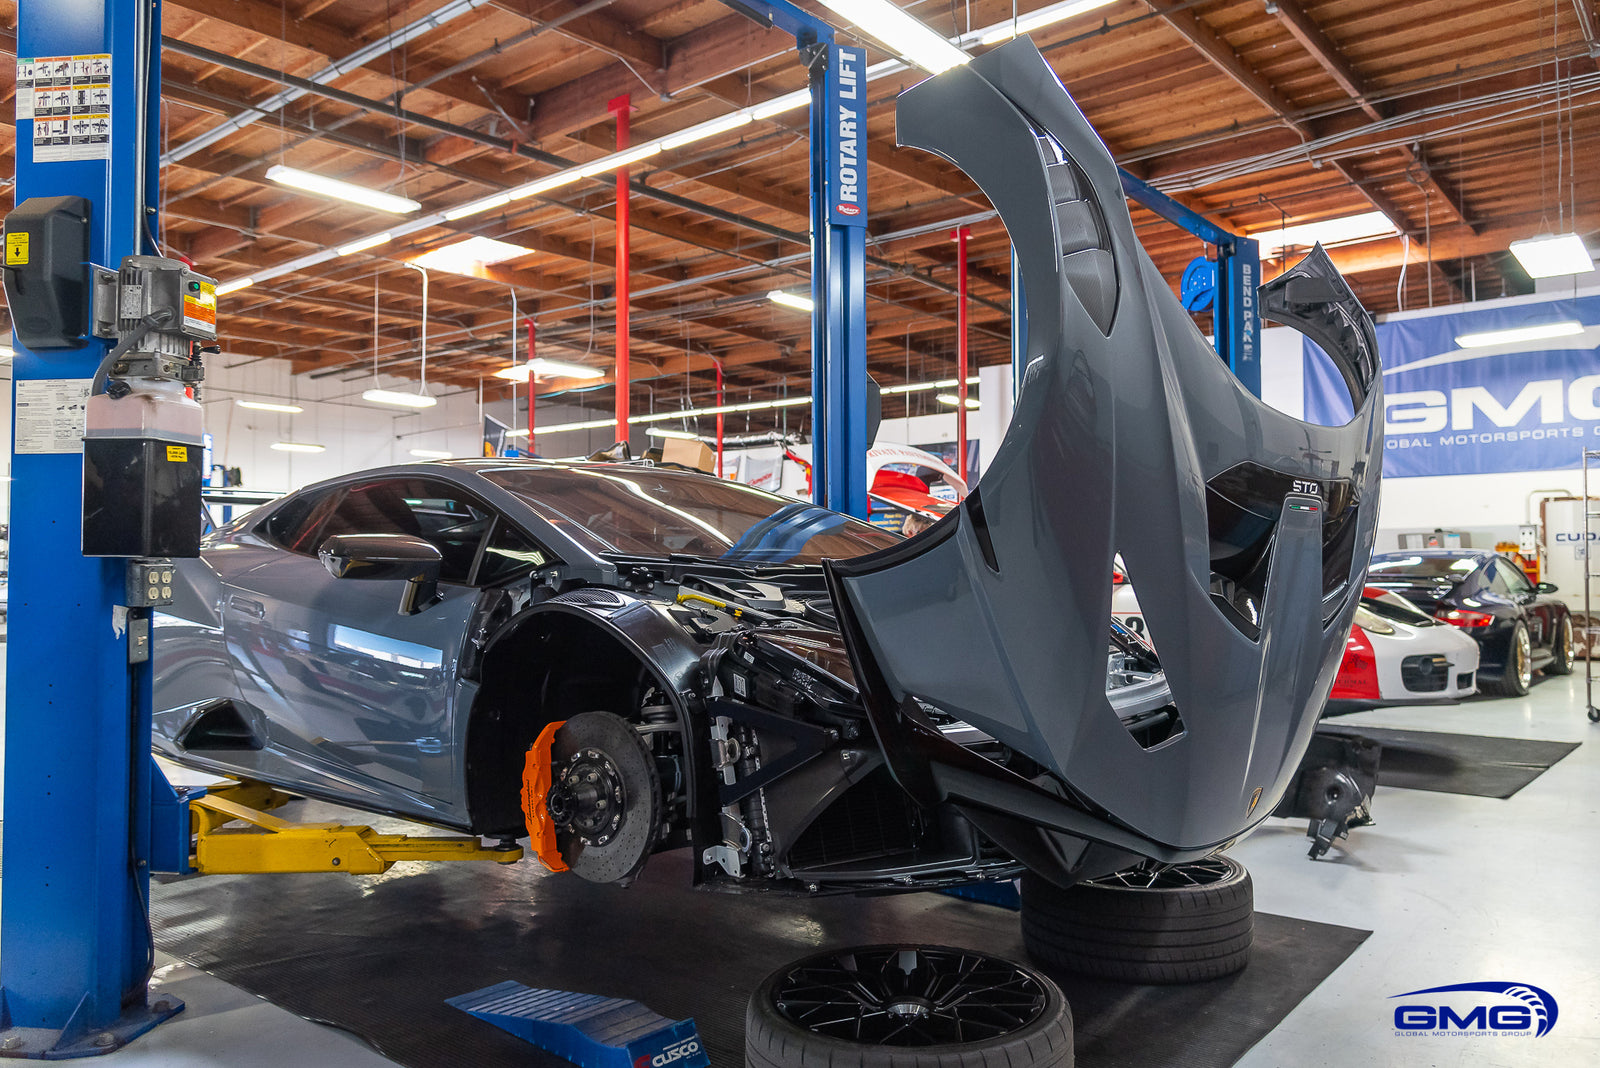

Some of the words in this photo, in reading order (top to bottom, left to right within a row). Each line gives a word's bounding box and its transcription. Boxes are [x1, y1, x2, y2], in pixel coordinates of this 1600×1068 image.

[838, 48, 857, 100] LIFT
[839, 104, 858, 203] ROTARY
[1242, 263, 1252, 307] BEND
[1384, 374, 1600, 436] GM
[1384, 438, 1432, 450] OBAL
[1439, 426, 1585, 446] MOTORSPORTS
[1292, 479, 1319, 495] STO
[1556, 532, 1600, 542] CUD
[652, 1041, 699, 1068] CUSCO
